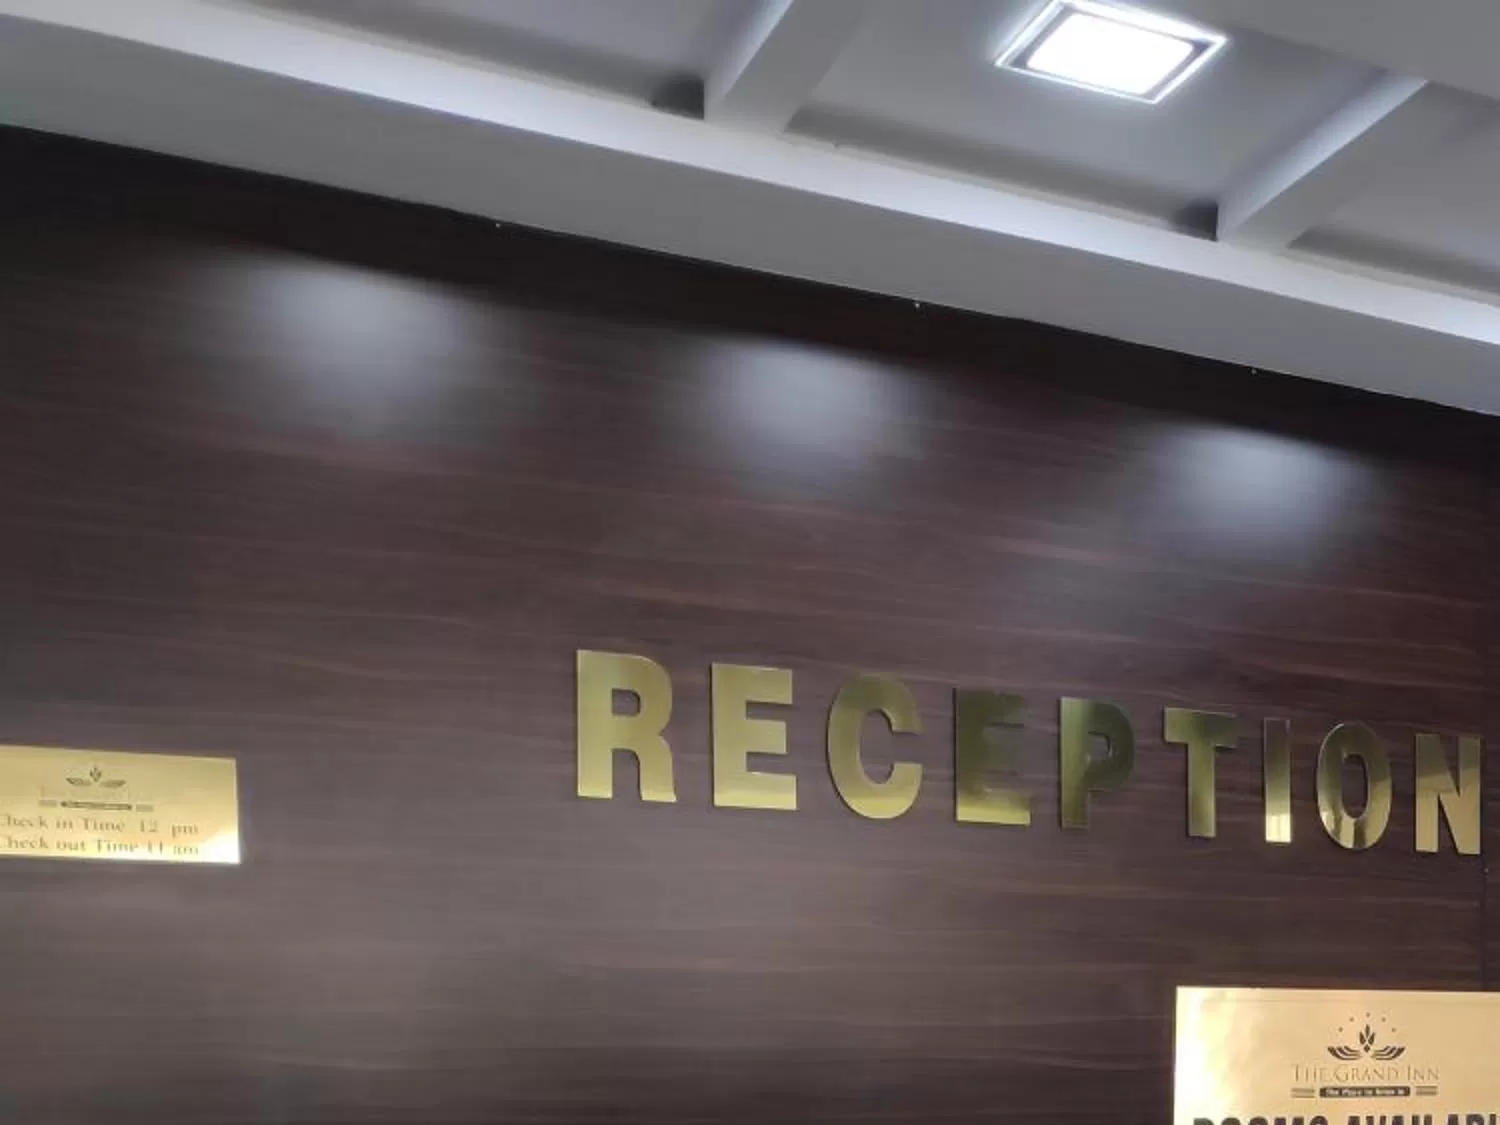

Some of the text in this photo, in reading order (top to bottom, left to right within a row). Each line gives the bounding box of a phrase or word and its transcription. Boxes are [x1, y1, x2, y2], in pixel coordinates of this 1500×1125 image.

[577, 649, 1481, 856] RECEPTION
[56, 815, 73, 829] in
[82, 817, 125, 832] Time
[140, 819, 157, 832] 12
[172, 823, 198, 838] pm
[56, 838, 86, 852] out
[96, 838, 139, 852] Time
[1333, 1063, 1399, 1082] GRAND
[1406, 1064, 1439, 1081] INN
